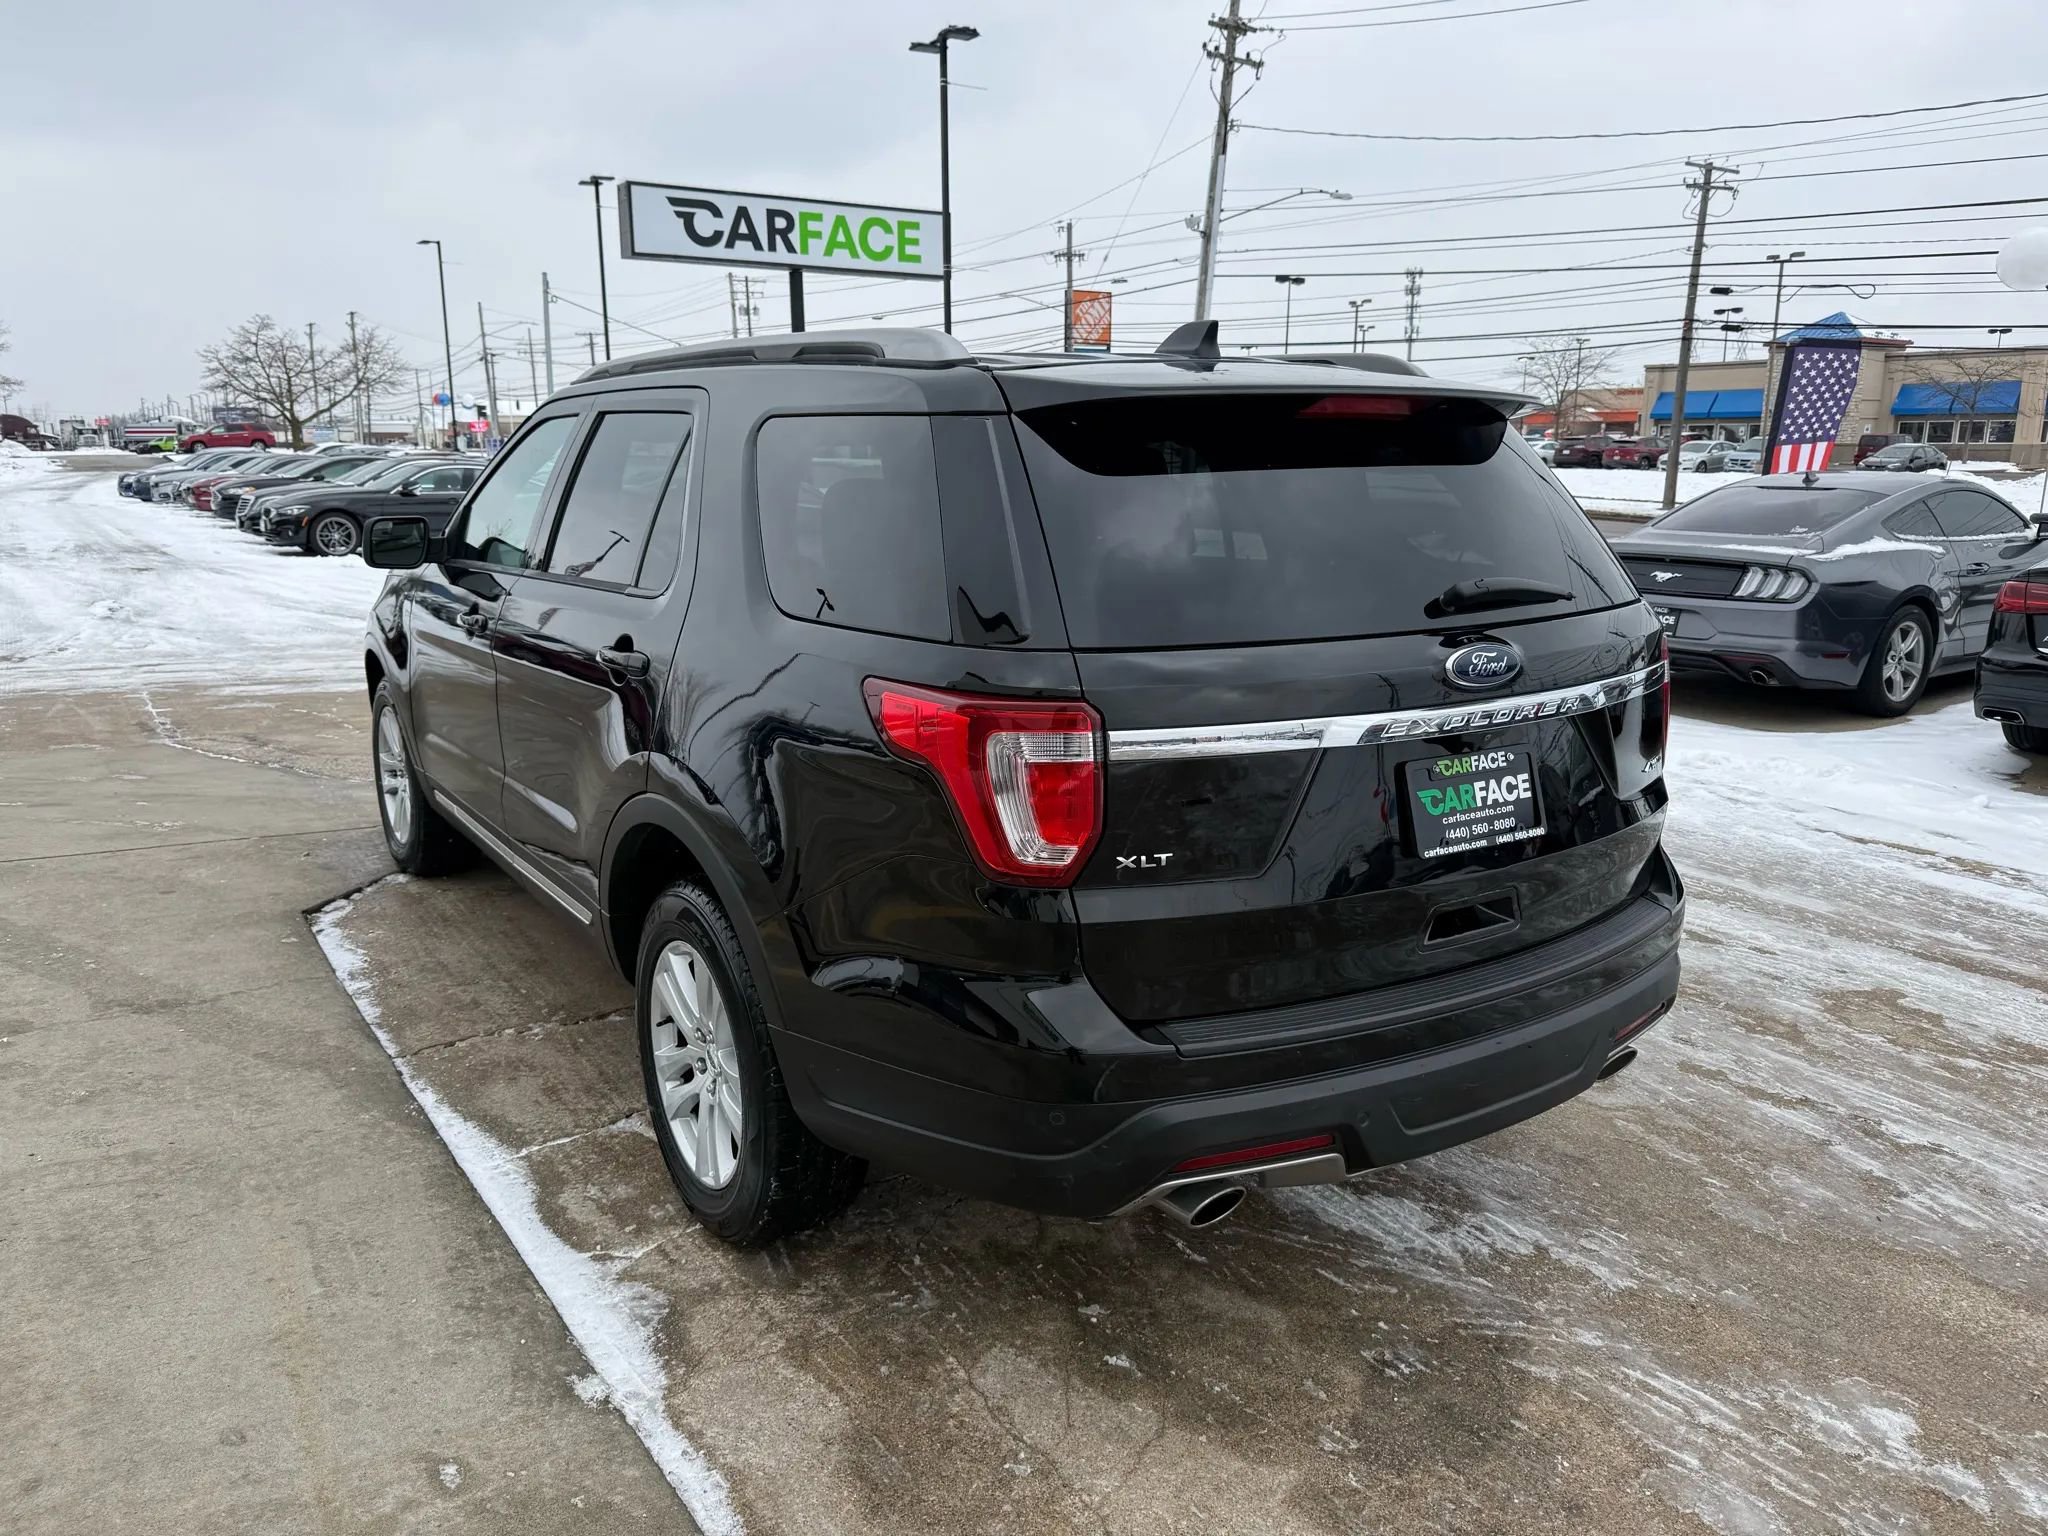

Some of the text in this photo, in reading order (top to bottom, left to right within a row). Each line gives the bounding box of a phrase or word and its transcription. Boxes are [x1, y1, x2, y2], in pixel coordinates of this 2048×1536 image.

[665, 196, 922, 264] CARFACE
[1469, 651, 1507, 677] Ford
[1381, 696, 1581, 738] EXPLORER
[1437, 751, 1507, 776] CARFACE
[1416, 773, 1532, 816] CARFACE
[1442, 804, 1514, 825] carfaceauto.com
[1445, 825, 1470, 840] (440)
[1424, 839, 1488, 858] carfaceauto.com
[1495, 833, 1514, 845] (440)
[1116, 852, 1174, 869] XLT
